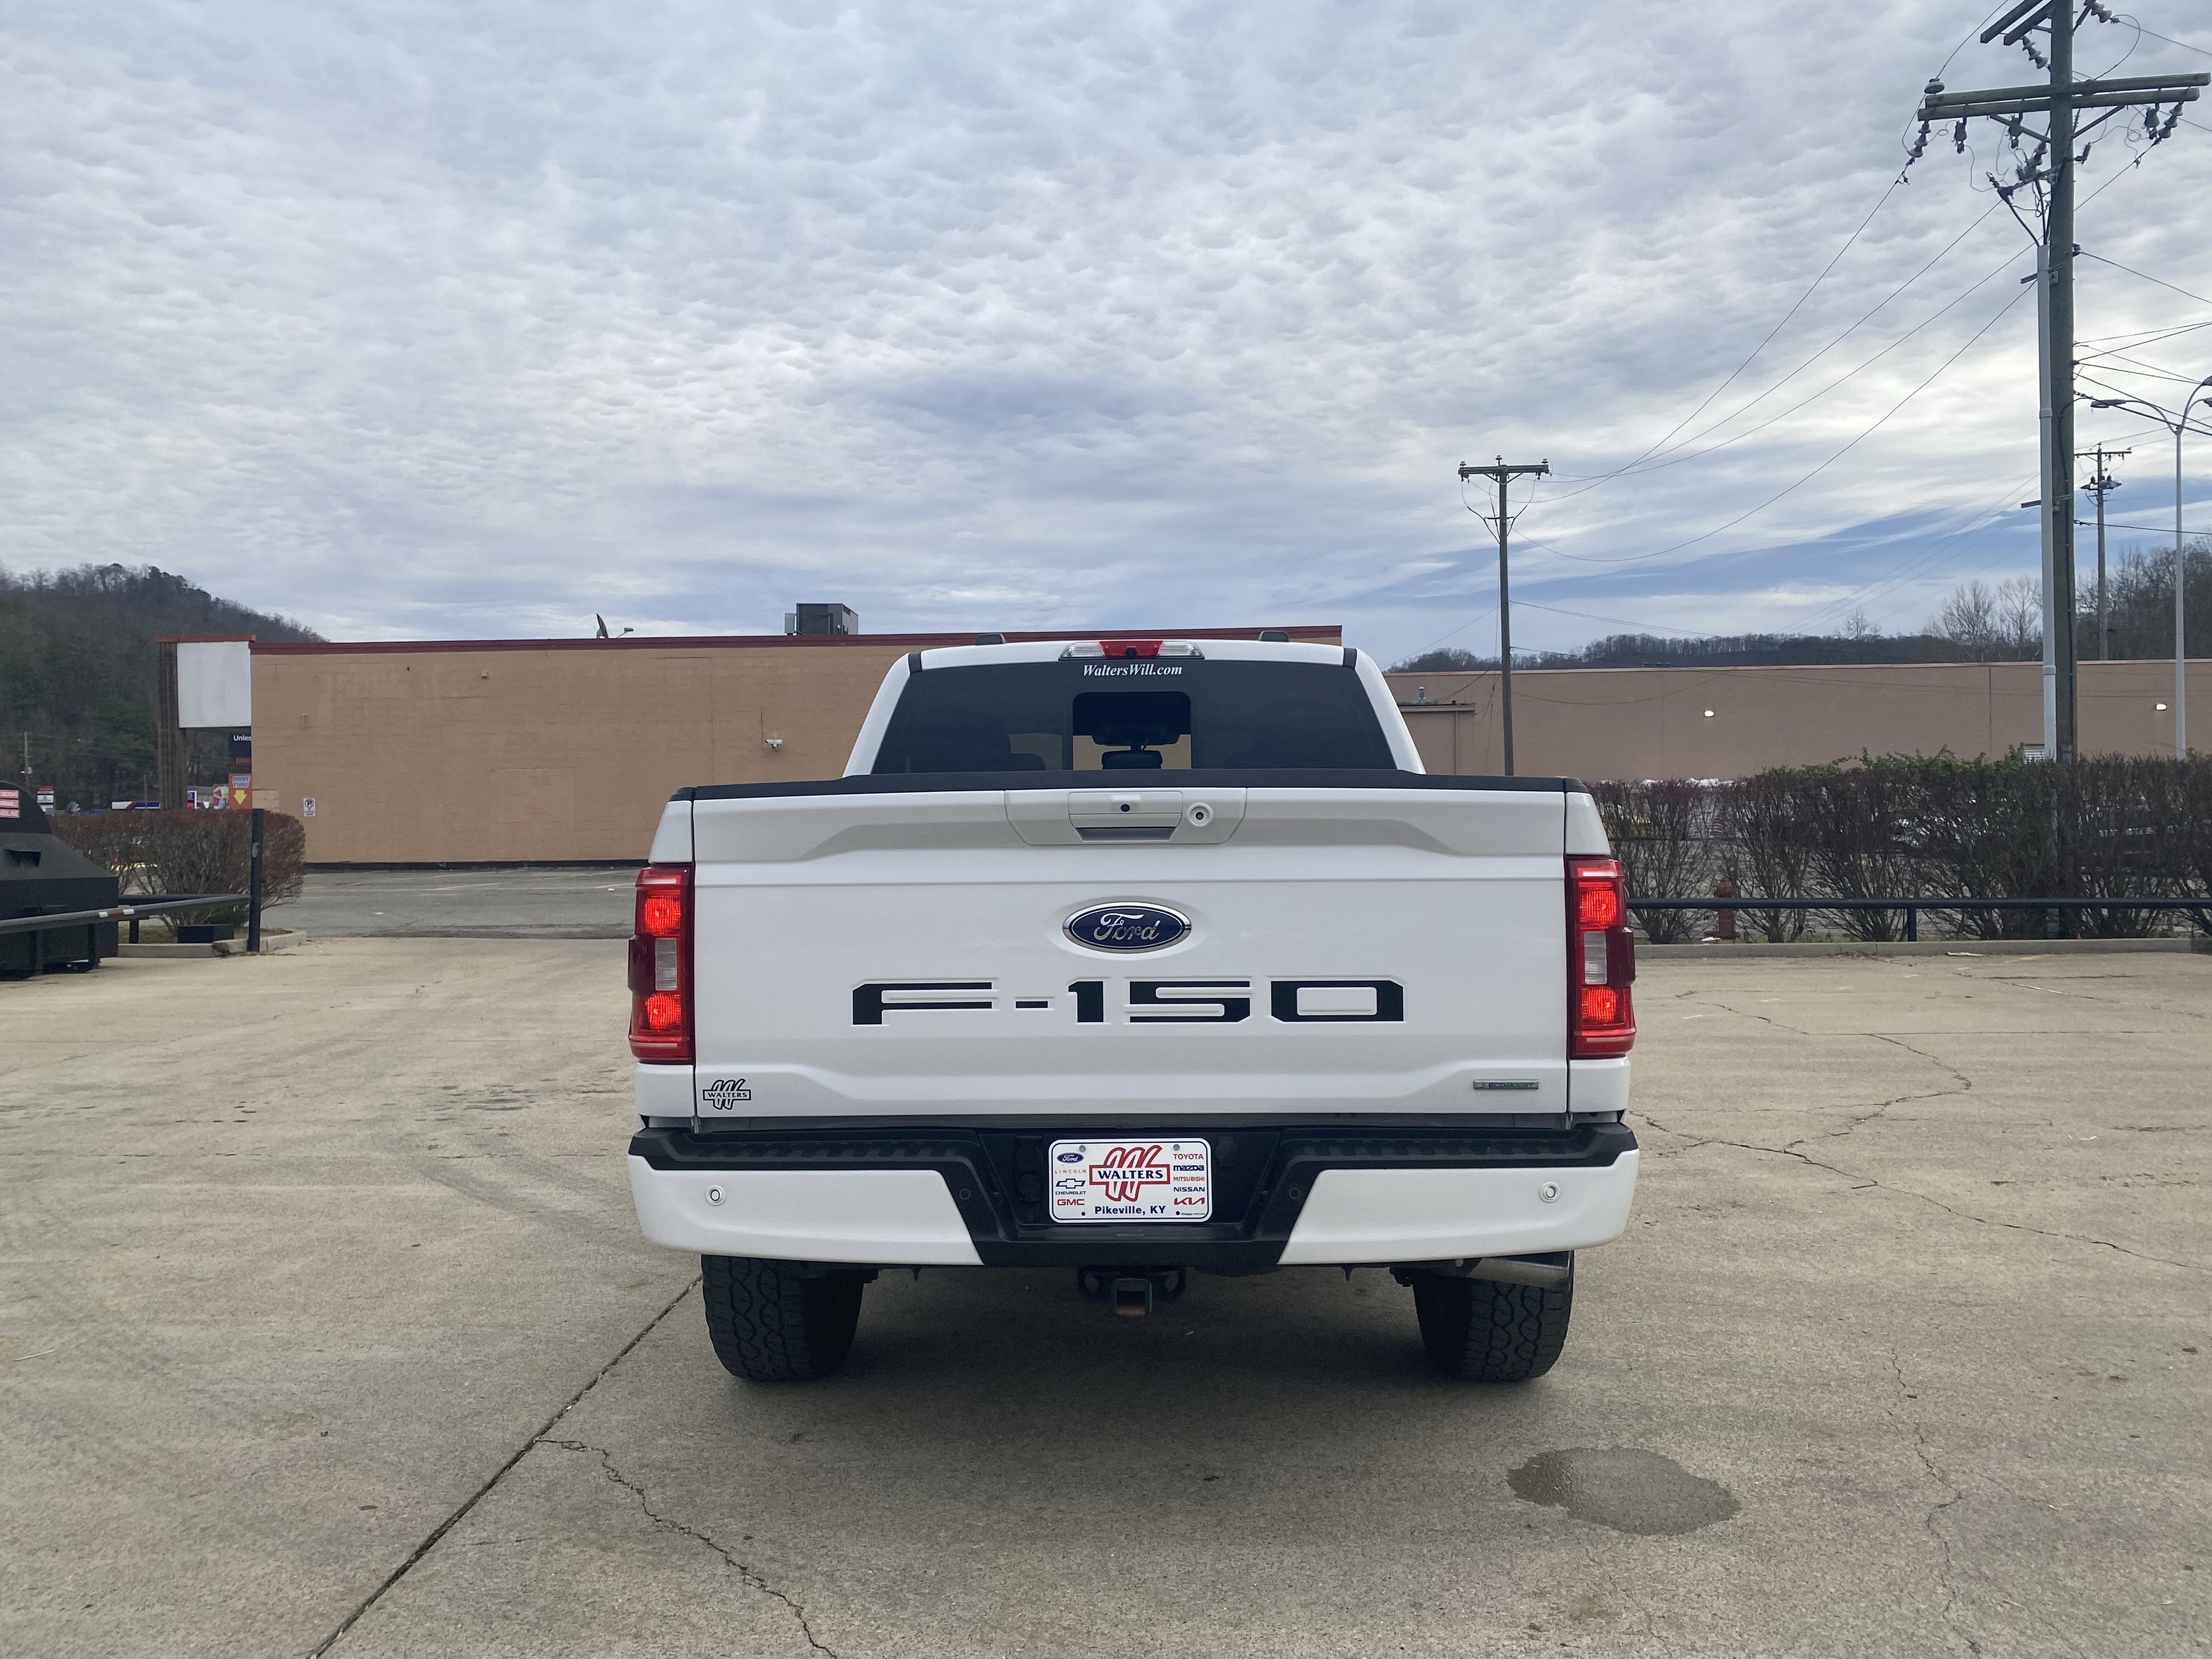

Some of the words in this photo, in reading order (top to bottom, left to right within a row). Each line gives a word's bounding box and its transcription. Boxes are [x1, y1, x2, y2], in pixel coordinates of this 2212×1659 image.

[1084, 663, 1183, 676] WaltersWill.com
[1093, 912, 1161, 941] Ford
[852, 980, 1404, 1025] F-150
[1097, 1170, 1164, 1180] WALTERS
[1094, 1206, 1146, 1216] Pikeville,
[1150, 1205, 1166, 1214] KY
